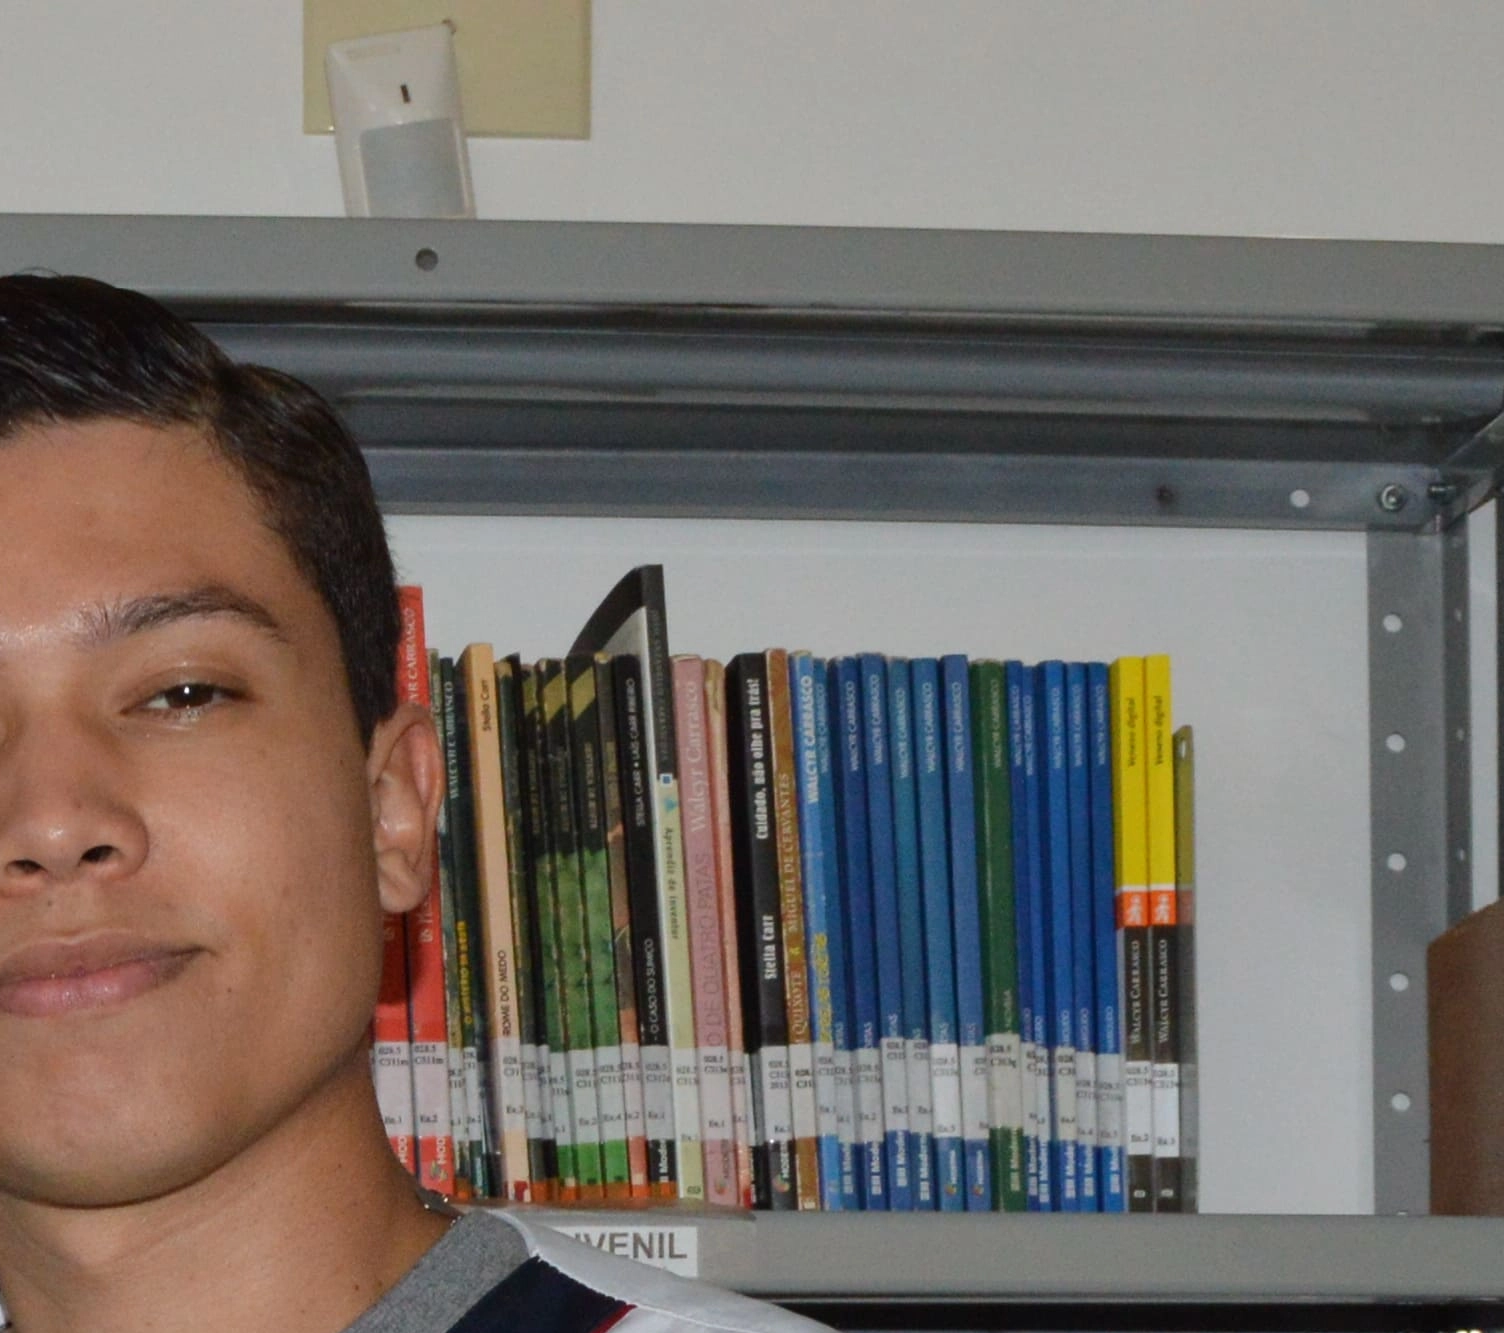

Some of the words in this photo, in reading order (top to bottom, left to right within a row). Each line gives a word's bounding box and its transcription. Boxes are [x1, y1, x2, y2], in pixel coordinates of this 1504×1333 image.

[402, 607, 418, 678] CARRASCO
[479, 679, 491, 701] Carr
[746, 678, 761, 705] trás!
[481, 703, 493, 731] Stella
[684, 680, 703, 762] Carrasco
[749, 709, 765, 729] pra
[800, 676, 817, 746] CARRASCO
[1123, 697, 1138, 729] digital
[1152, 695, 1166, 729] digital
[750, 731, 764, 758] olhe
[1125, 731, 1138, 768] Veneno
[1154, 731, 1165, 765] Veneno
[752, 761, 765, 783] não
[803, 749, 820, 804] WALCYR
[689, 768, 707, 832] Walcyr
[753, 787, 771, 839] Cuidado,
[778, 772, 796, 852] CERVANTES
[783, 857, 797, 876] DE
[785, 881, 799, 932] MIGUEL
[761, 915, 775, 941] Carr
[763, 945, 778, 979] Stella
